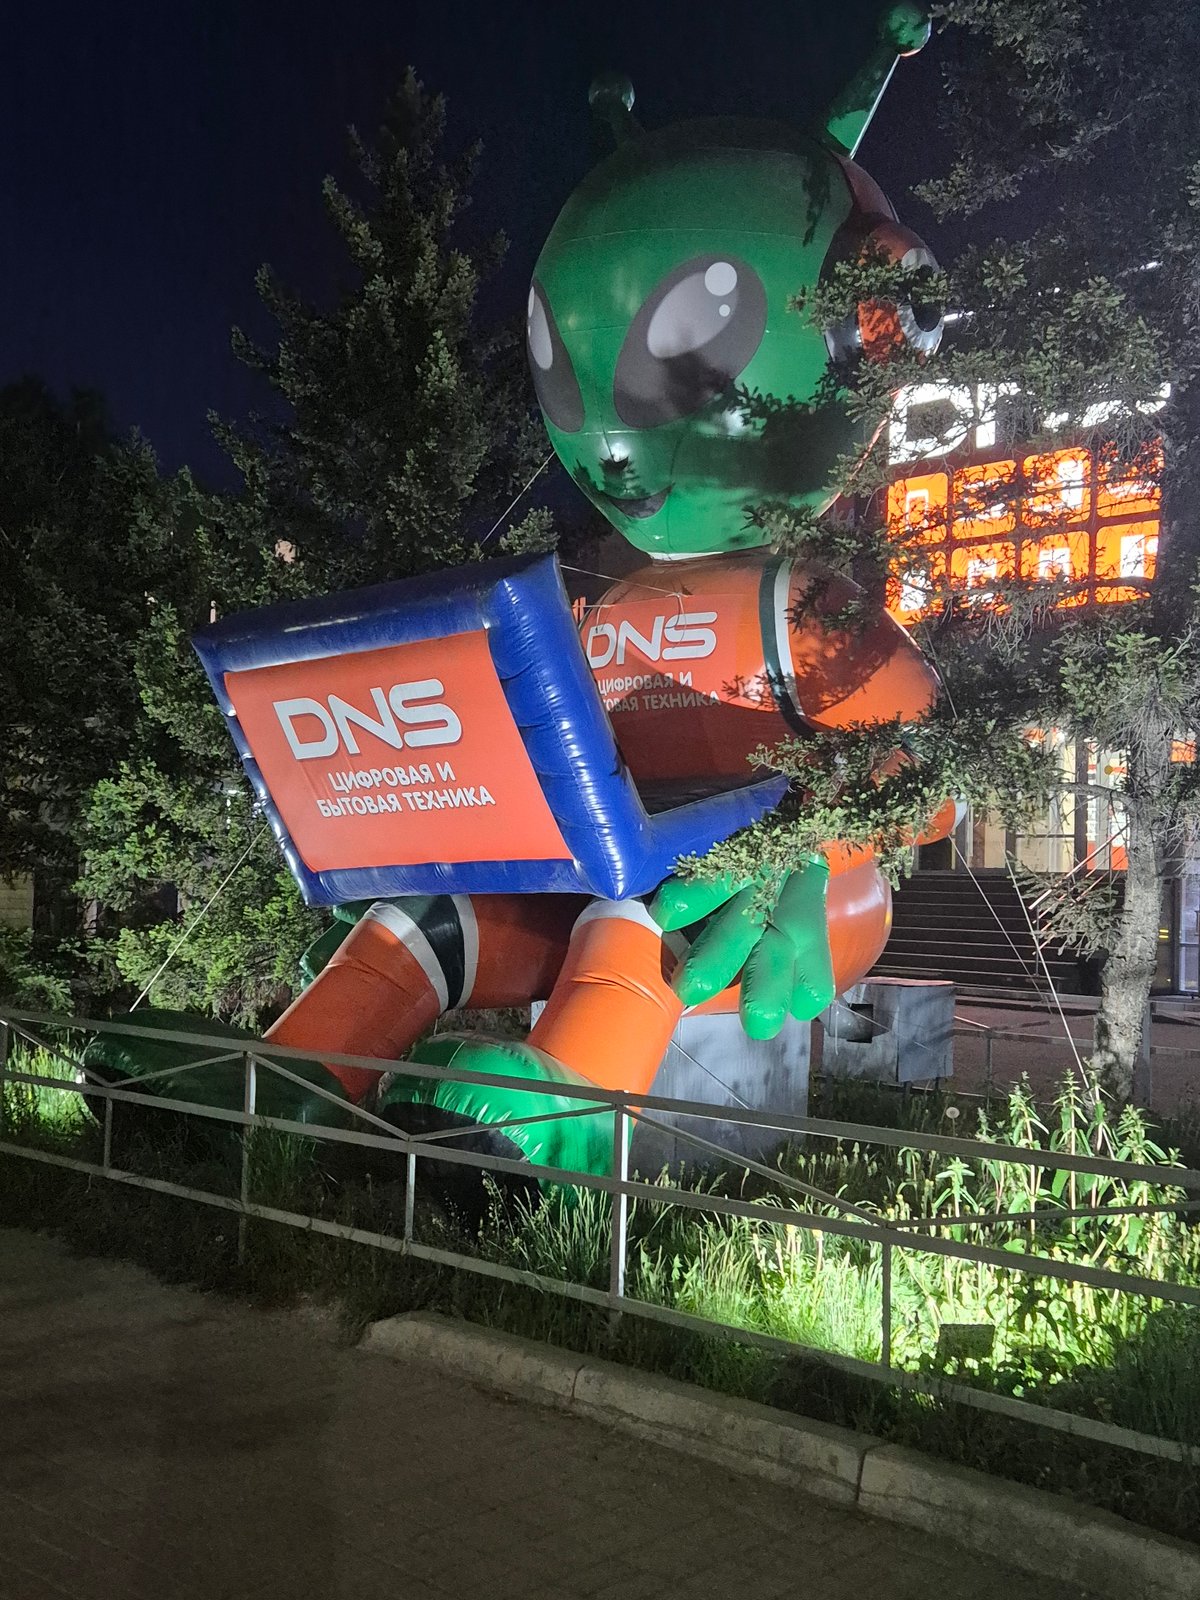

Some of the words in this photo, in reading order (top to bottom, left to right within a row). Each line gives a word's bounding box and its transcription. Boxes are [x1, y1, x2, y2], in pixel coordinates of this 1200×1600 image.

[585, 611, 718, 669] DNS
[598, 672, 674, 696] ЦИФРОВАЯ
[679, 671, 693, 687] И
[642, 690, 722, 711] ТЕХНИКА
[272, 678, 463, 760] DNS
[328, 763, 435, 793] ЦИФРОВАЯ
[436, 761, 456, 783] И
[316, 795, 404, 818] БЫТОВАЯ
[402, 785, 497, 812] ТЕХНИКА
